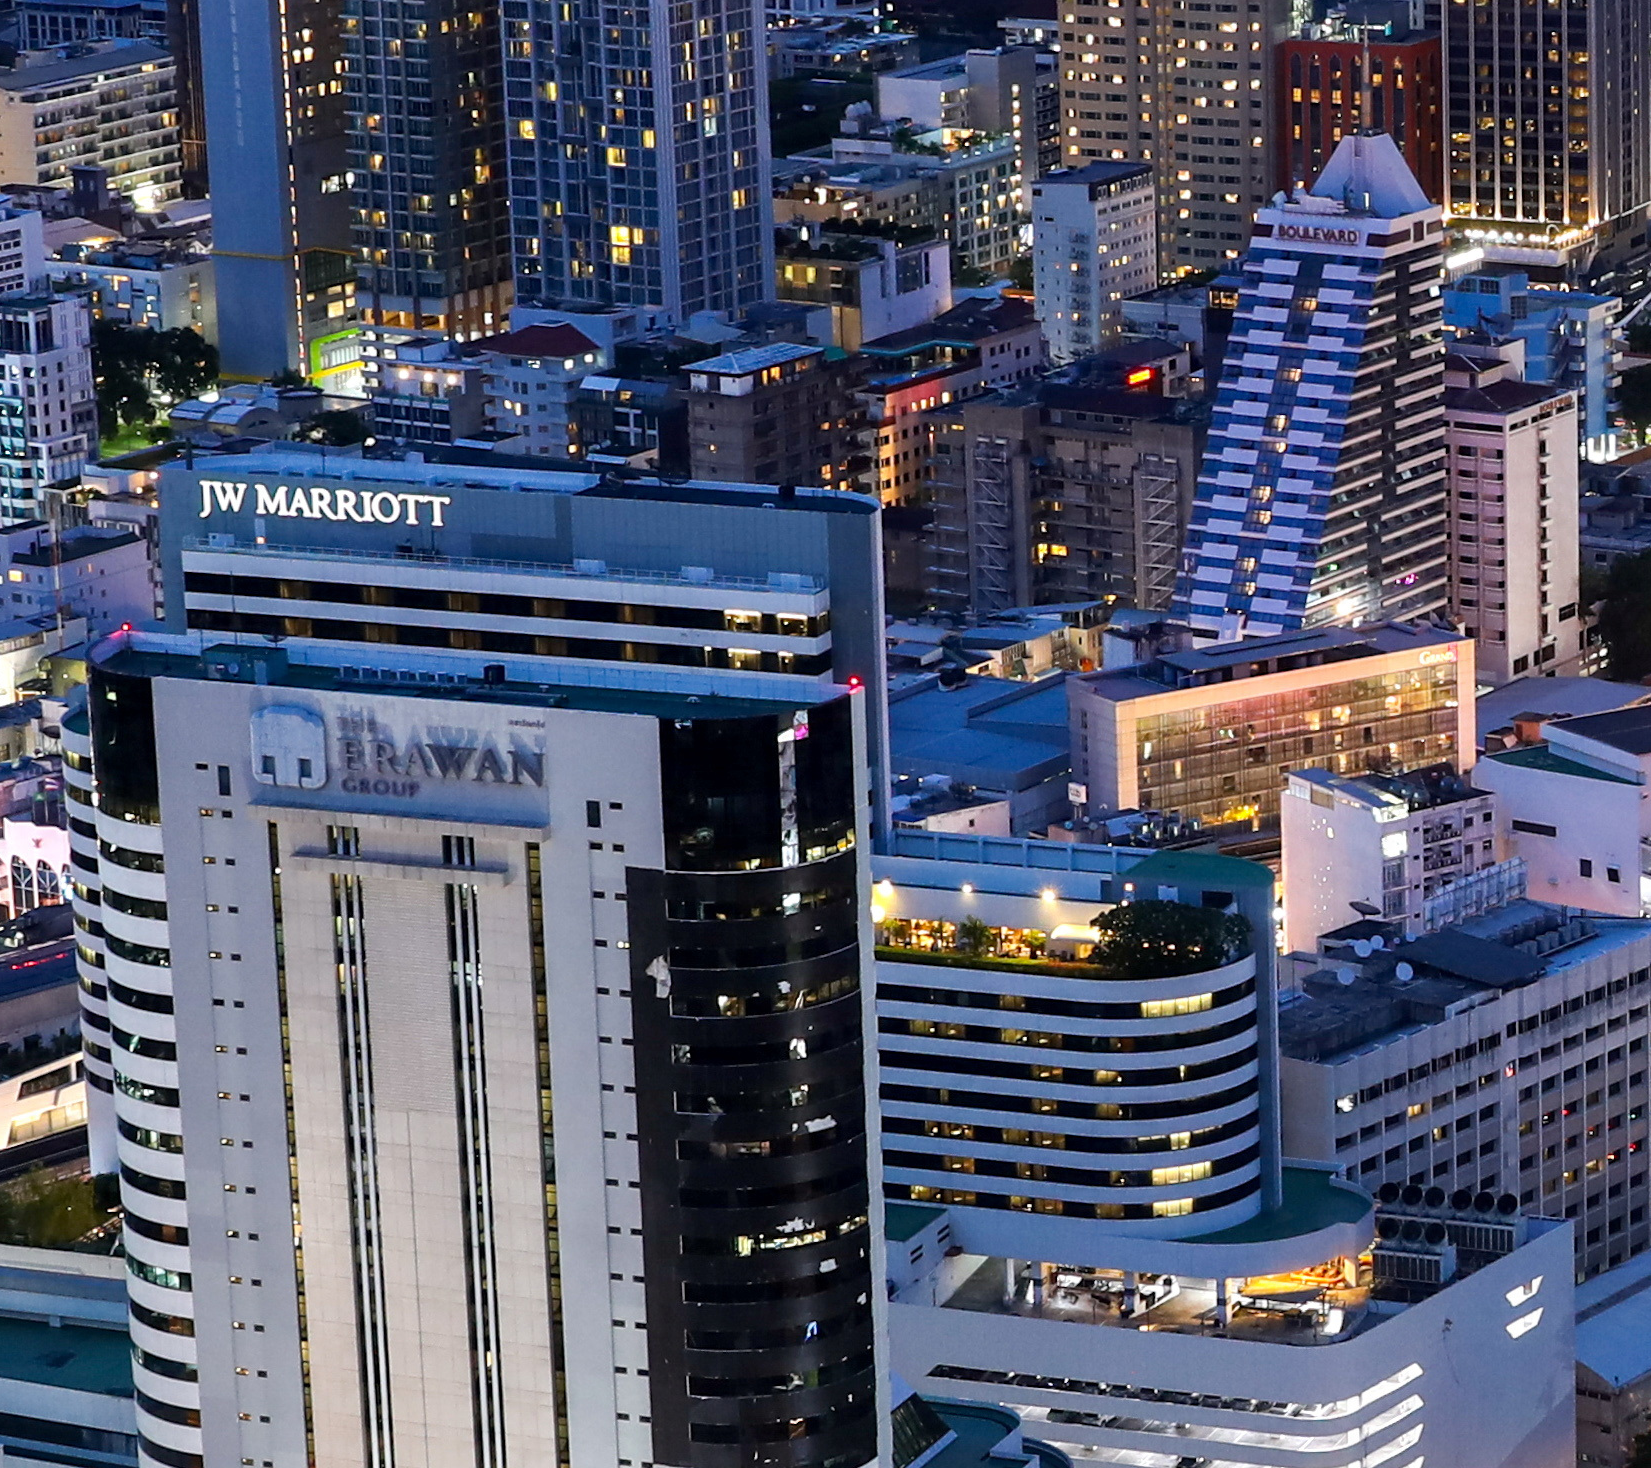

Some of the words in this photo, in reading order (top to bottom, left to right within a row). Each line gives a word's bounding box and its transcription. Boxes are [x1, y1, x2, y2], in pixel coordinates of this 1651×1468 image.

[1277, 223, 1359, 245] BOULEVARD
[199, 480, 248, 519] JW
[254, 484, 451, 527] MARRIOTT
[337, 737, 546, 788] ERAWAN
[340, 778, 421, 798] GROUP
